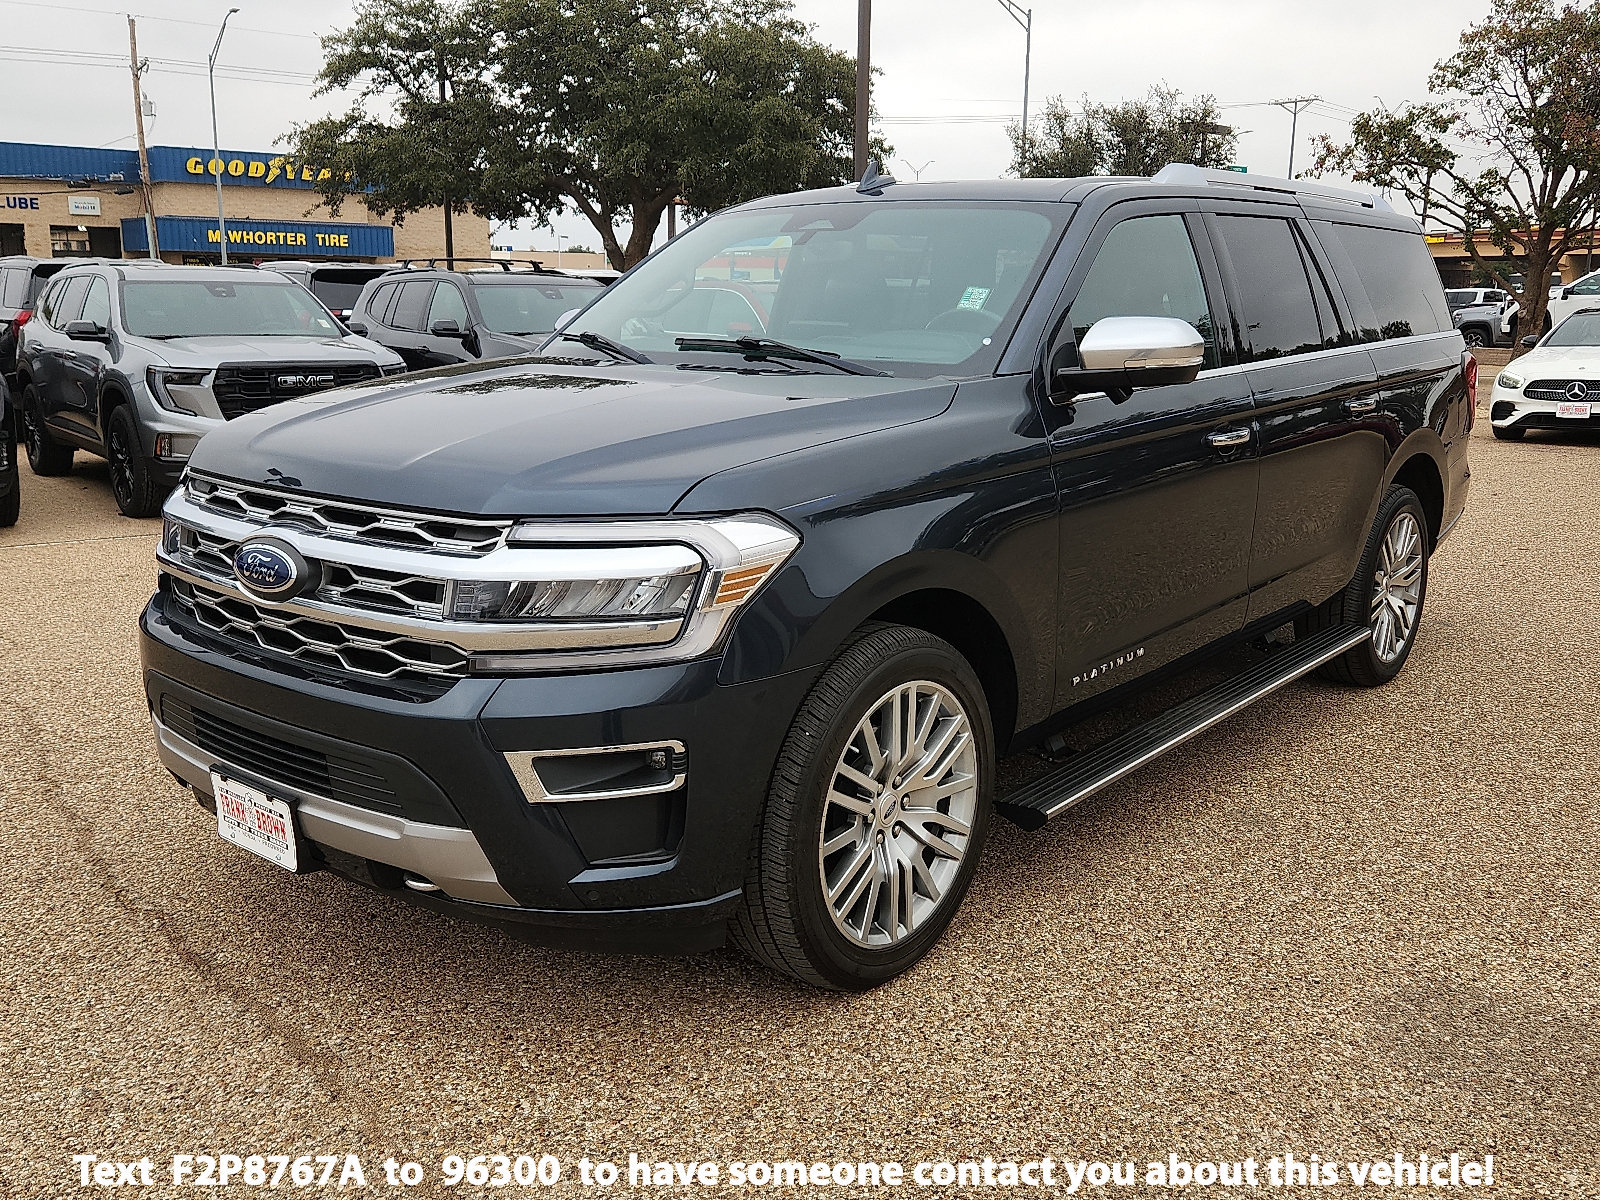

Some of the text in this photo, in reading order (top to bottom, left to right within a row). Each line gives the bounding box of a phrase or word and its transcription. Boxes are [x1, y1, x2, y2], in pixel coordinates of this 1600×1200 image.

[207, 229, 349, 247] MWHORTER TIRE
[277, 375, 335, 388] GMC
[243, 552, 279, 583] Ford
[1072, 647, 1146, 687] PLATINUM
[219, 792, 249, 824] FRANK
[255, 808, 288, 842] BROWN
